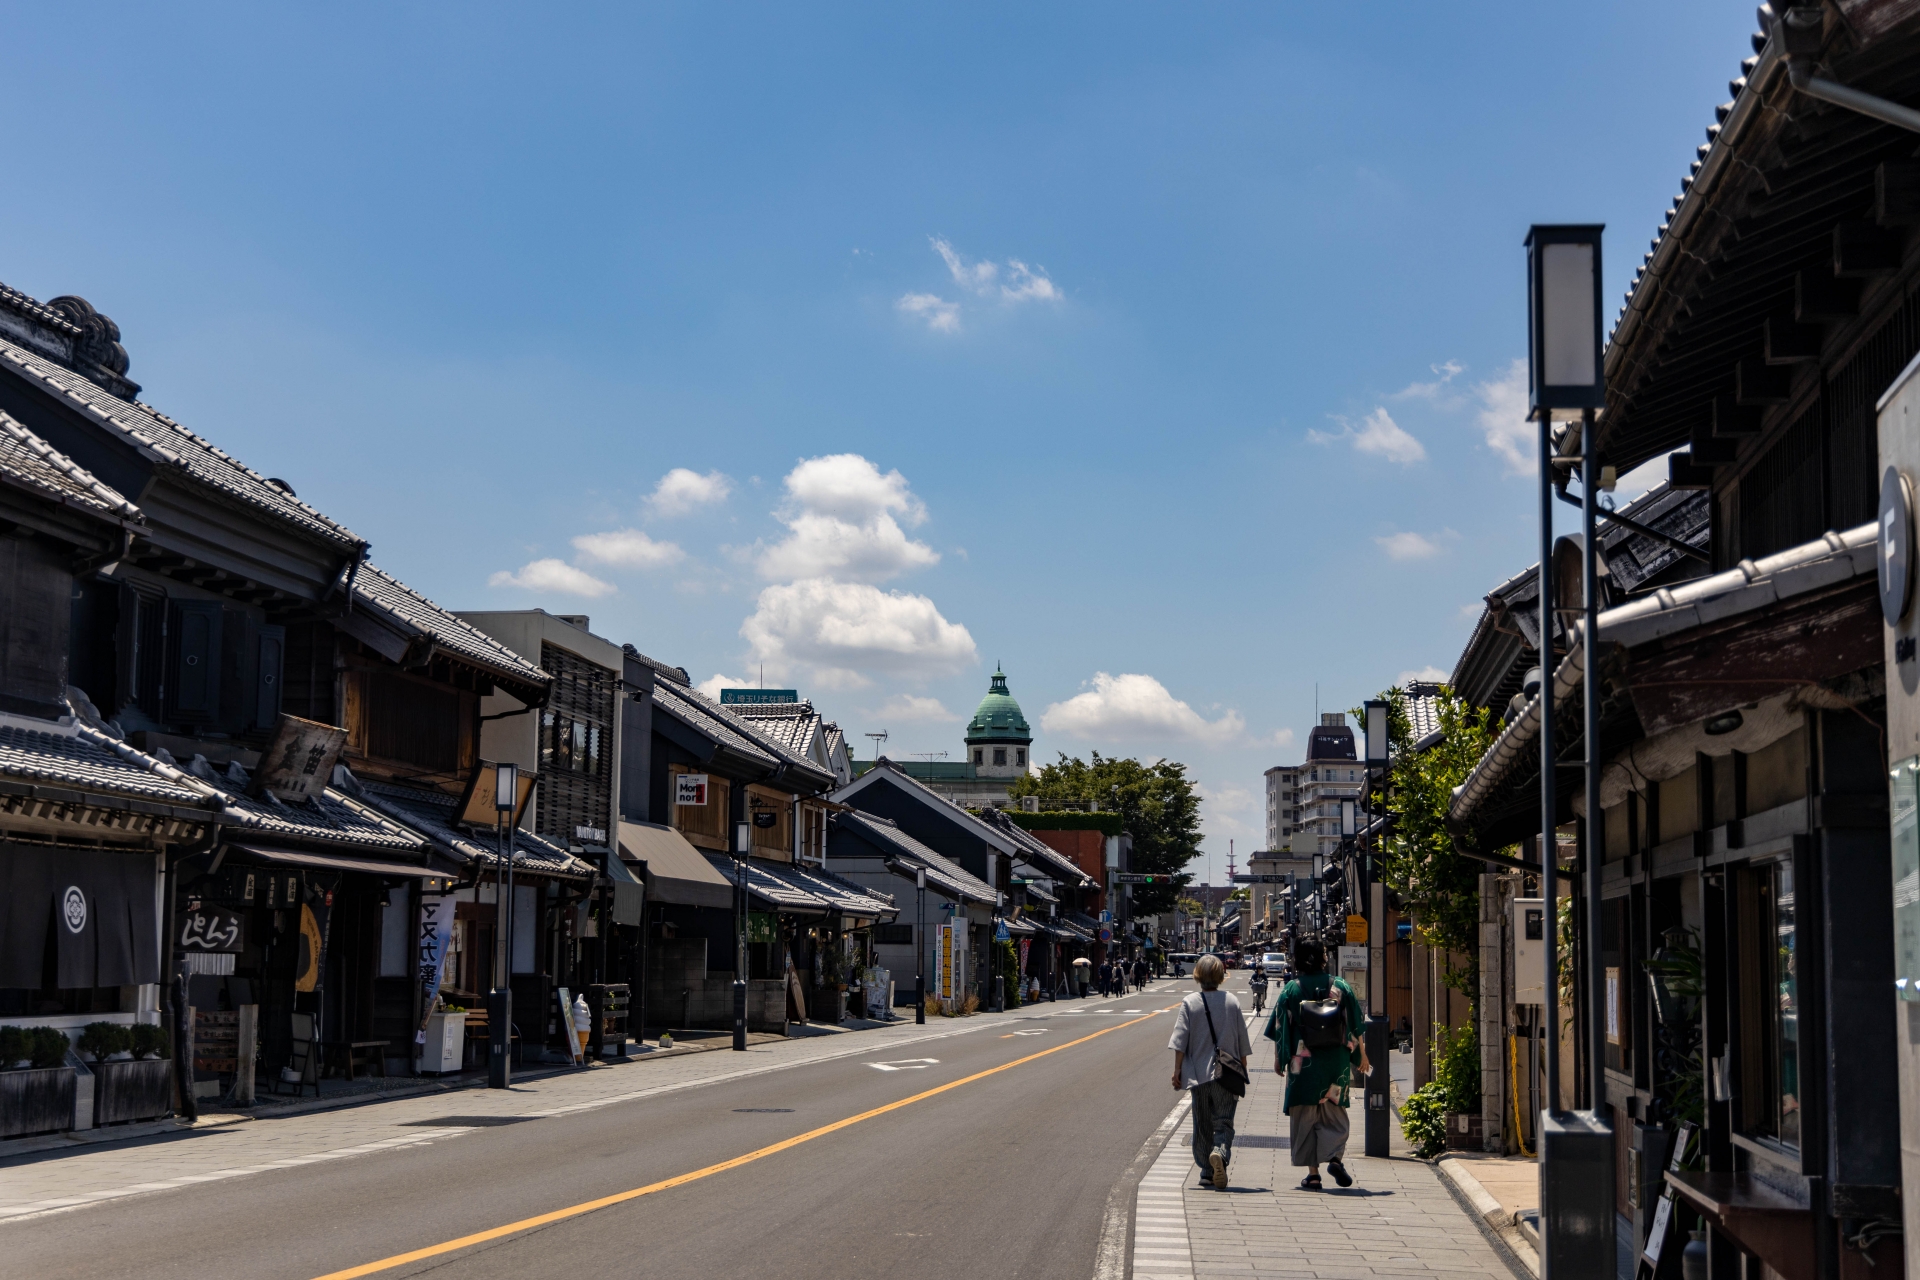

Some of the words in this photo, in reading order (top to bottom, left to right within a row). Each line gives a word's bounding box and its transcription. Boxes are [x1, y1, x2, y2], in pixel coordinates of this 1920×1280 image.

[737, 694, 794, 703] 埼玉りそな銀行
[679, 783, 703, 793] Mont
[679, 792, 703, 802] nord
